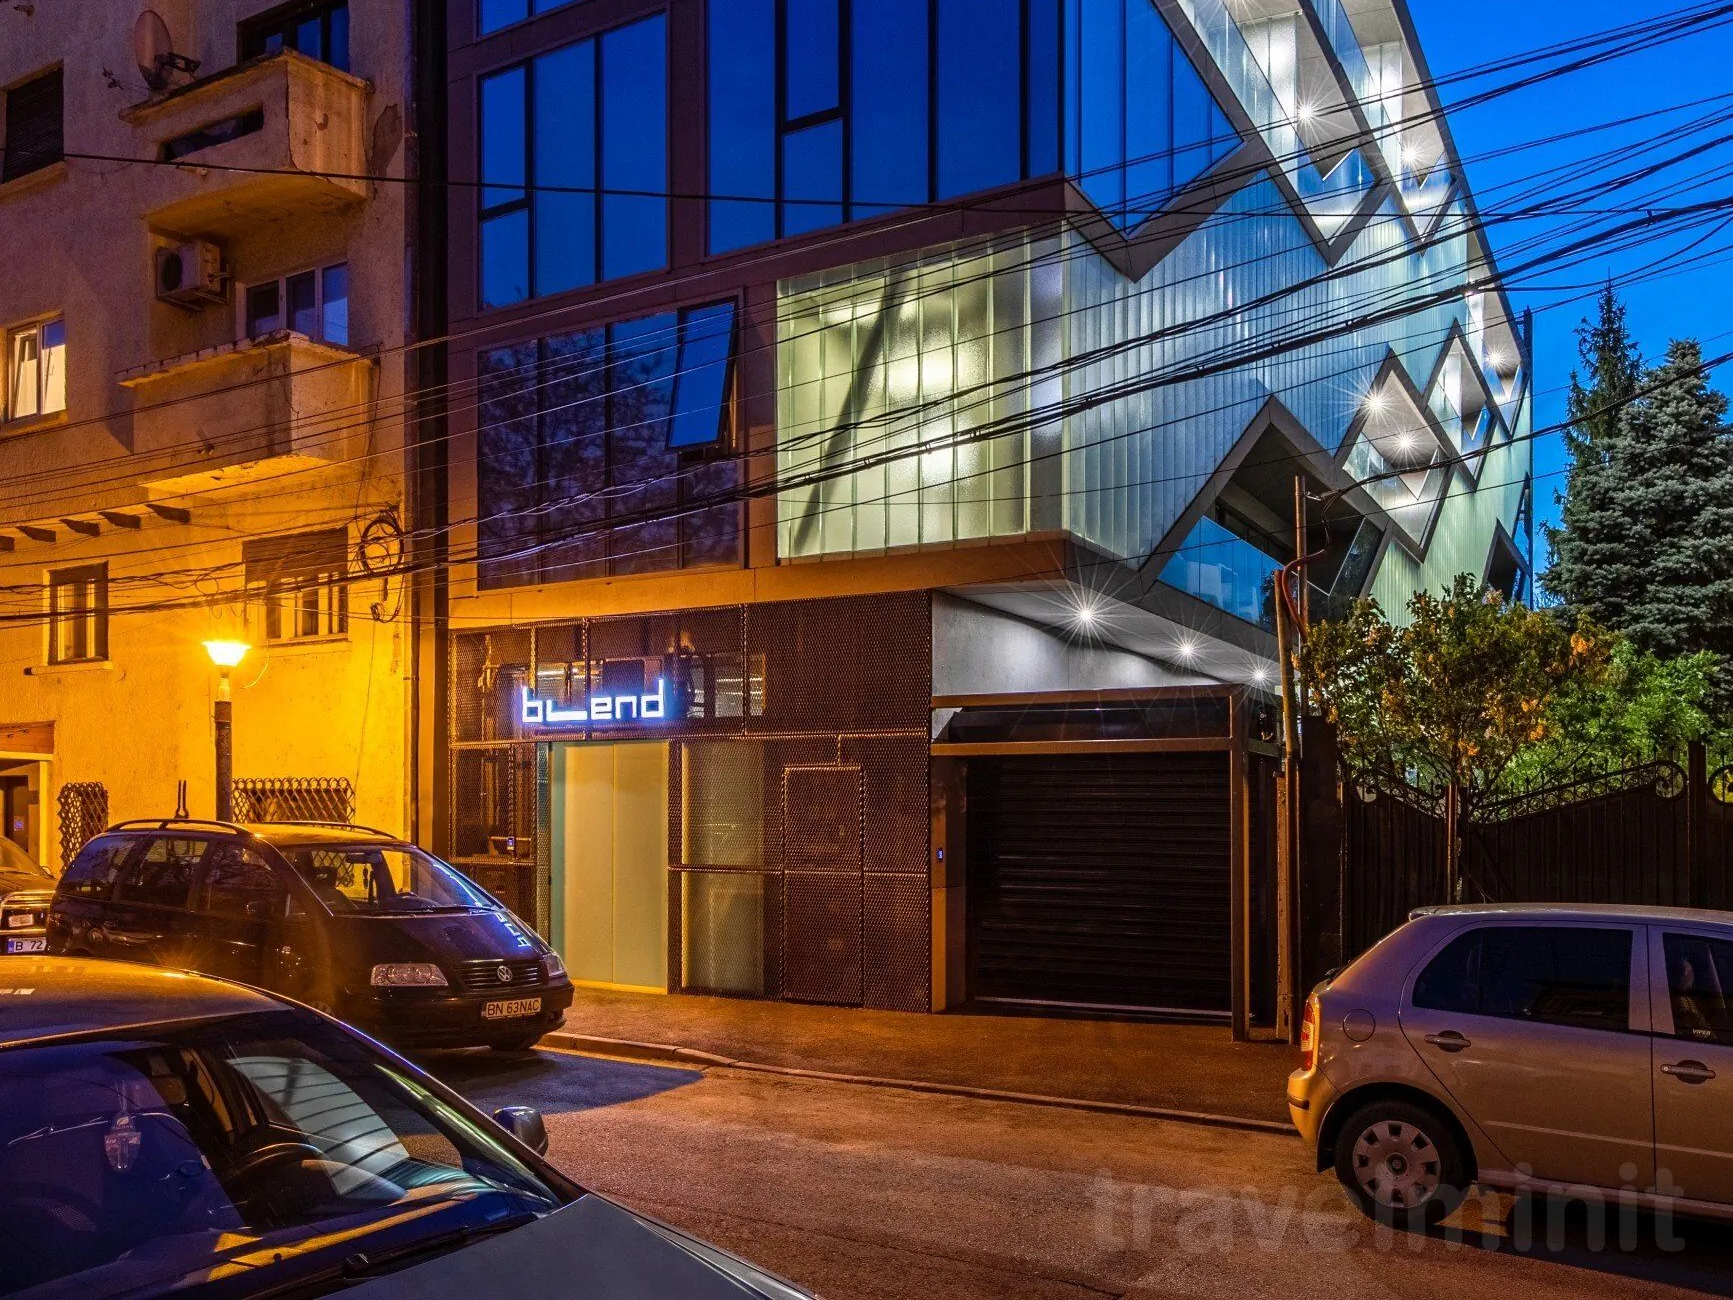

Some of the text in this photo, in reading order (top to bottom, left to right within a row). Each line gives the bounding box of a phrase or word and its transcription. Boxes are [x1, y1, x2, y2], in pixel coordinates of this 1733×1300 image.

[15, 940, 43, 951] B 72
[487, 1002, 504, 1016] BN
